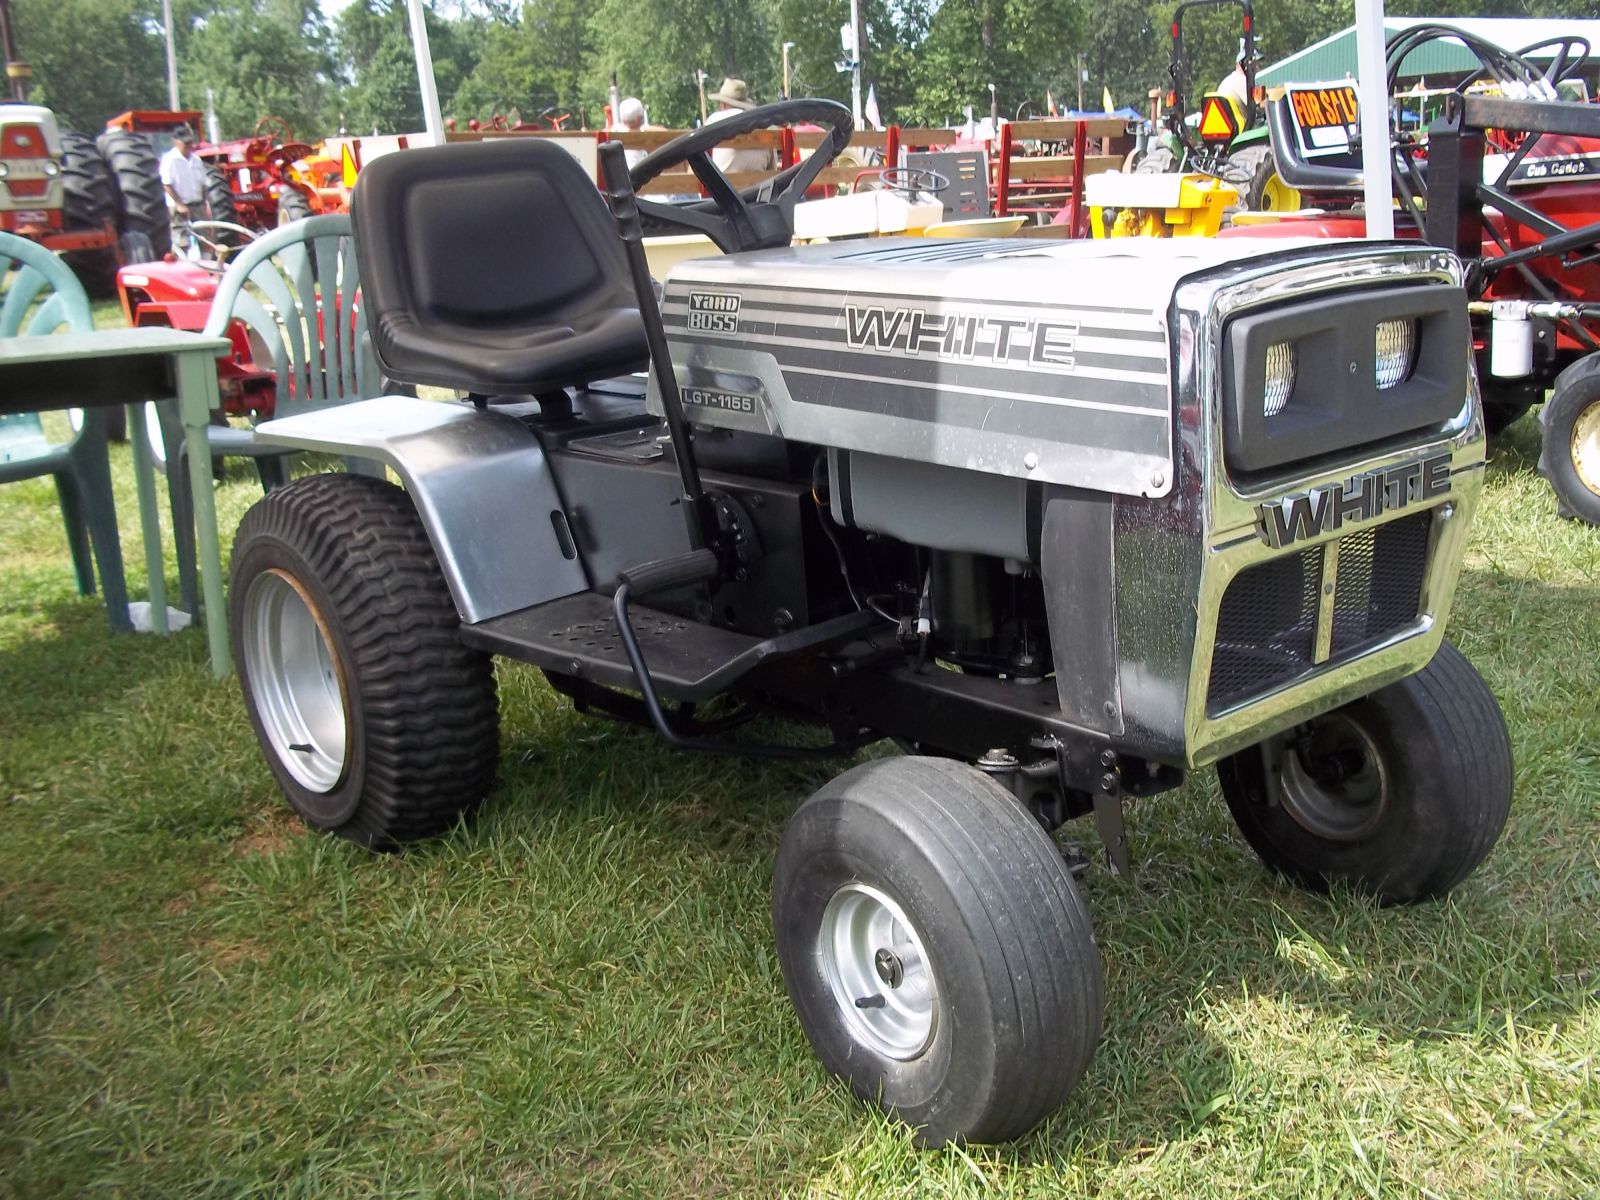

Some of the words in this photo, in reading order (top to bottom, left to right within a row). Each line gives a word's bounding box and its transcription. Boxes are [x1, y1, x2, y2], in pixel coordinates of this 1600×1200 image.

[1292, 91, 1326, 127] FOR
[1527, 163, 1547, 178] Cub
[1551, 161, 1585, 175] Cadet
[690, 312, 736, 331] BOSS
[846, 304, 1080, 371] WHITE
[684, 390, 752, 411] LGT-1155
[1260, 453, 1453, 549] WHITE
